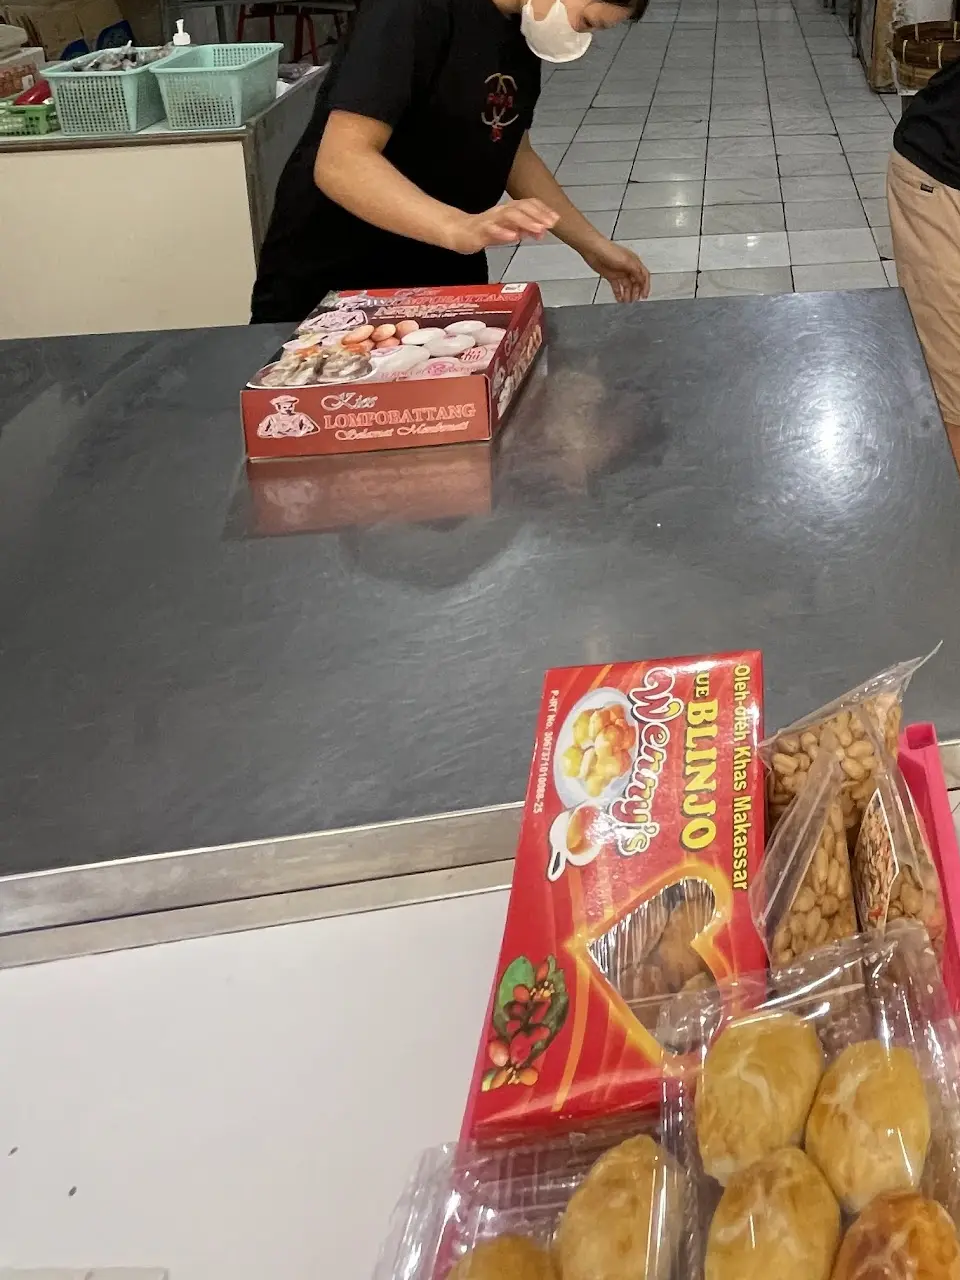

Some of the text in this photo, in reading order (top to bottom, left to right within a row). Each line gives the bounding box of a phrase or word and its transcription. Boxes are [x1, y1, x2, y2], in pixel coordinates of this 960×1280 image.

[323, 403, 477, 430] LOMPOBATTANG
[545, 714, 557, 730] No.
[609, 666, 685, 856] Wenny's
[682, 664, 718, 849] UE BLINJO
[732, 663, 752, 890] Oleh-oleh Khas Makassar
